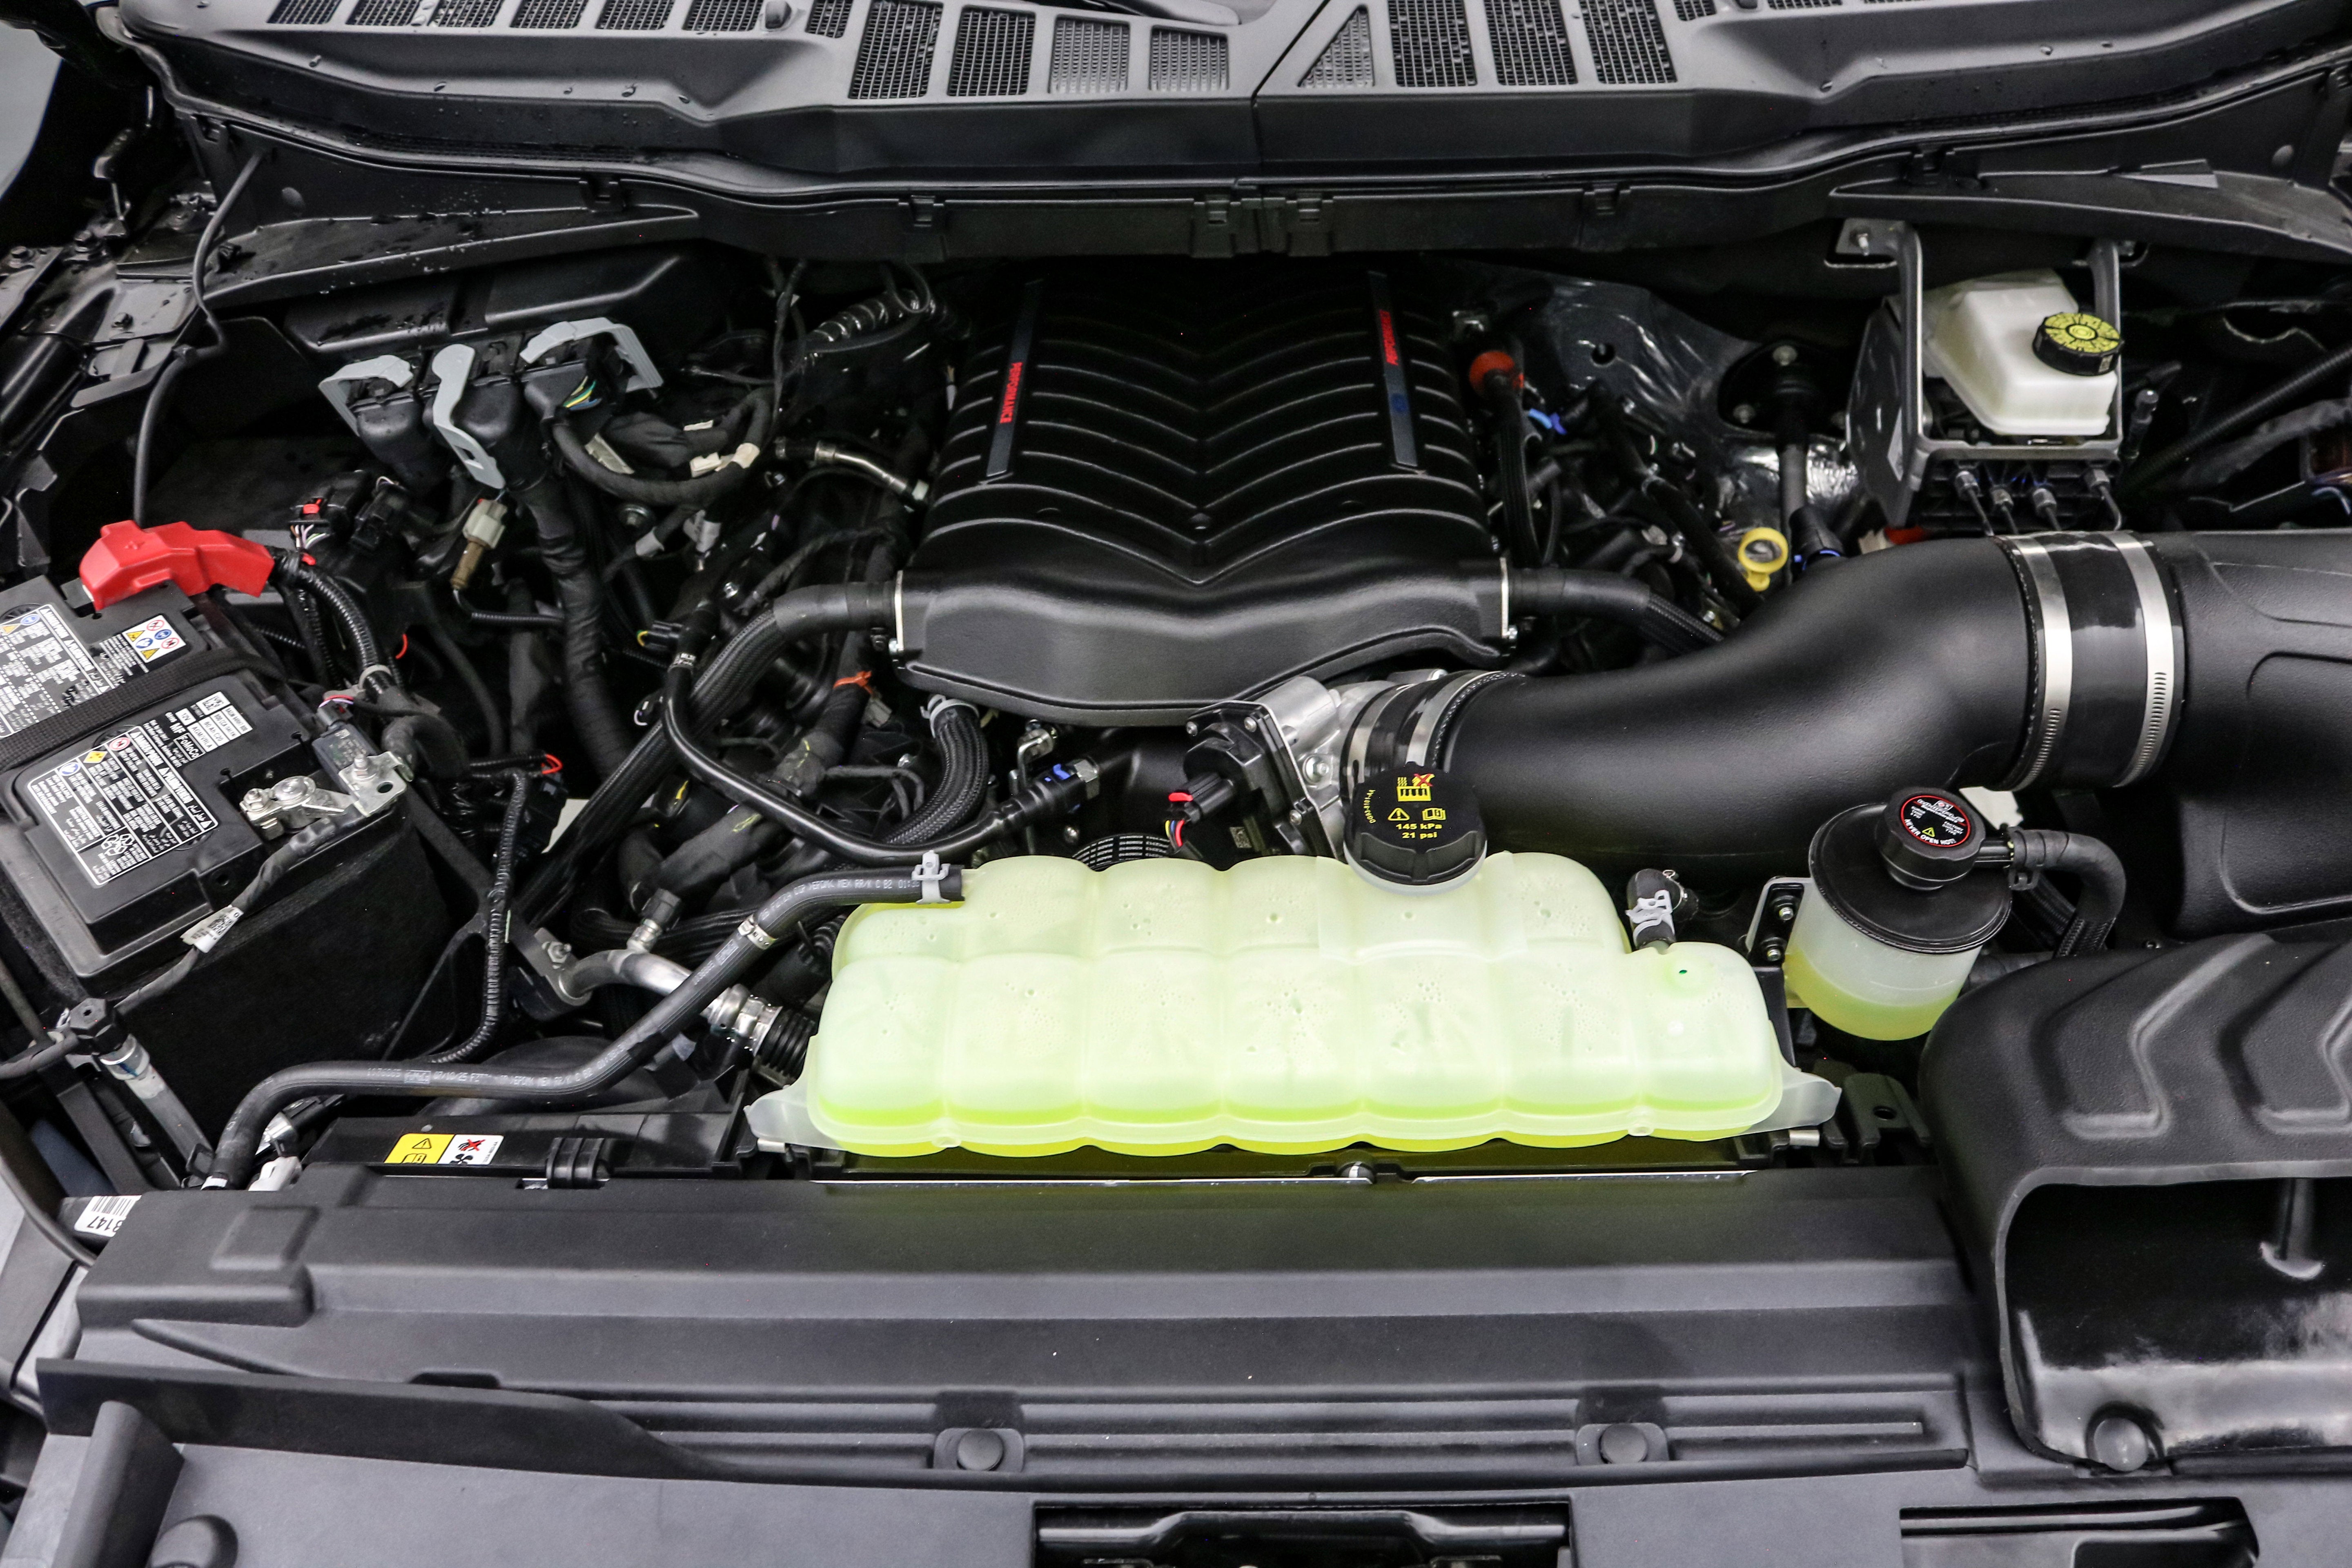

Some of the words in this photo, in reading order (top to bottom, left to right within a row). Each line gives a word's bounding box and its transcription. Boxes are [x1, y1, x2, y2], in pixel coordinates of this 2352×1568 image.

[1000, 362, 1023, 423] PERFORMANCE
[169, 722, 186, 735] MF
[180, 712, 191, 721] 12V
[133, 735, 164, 767] DANGER/POISON
[177, 735, 201, 759] FoMoCo
[1904, 819, 1921, 836] NEVER
[1920, 834, 1939, 844] OPEN
